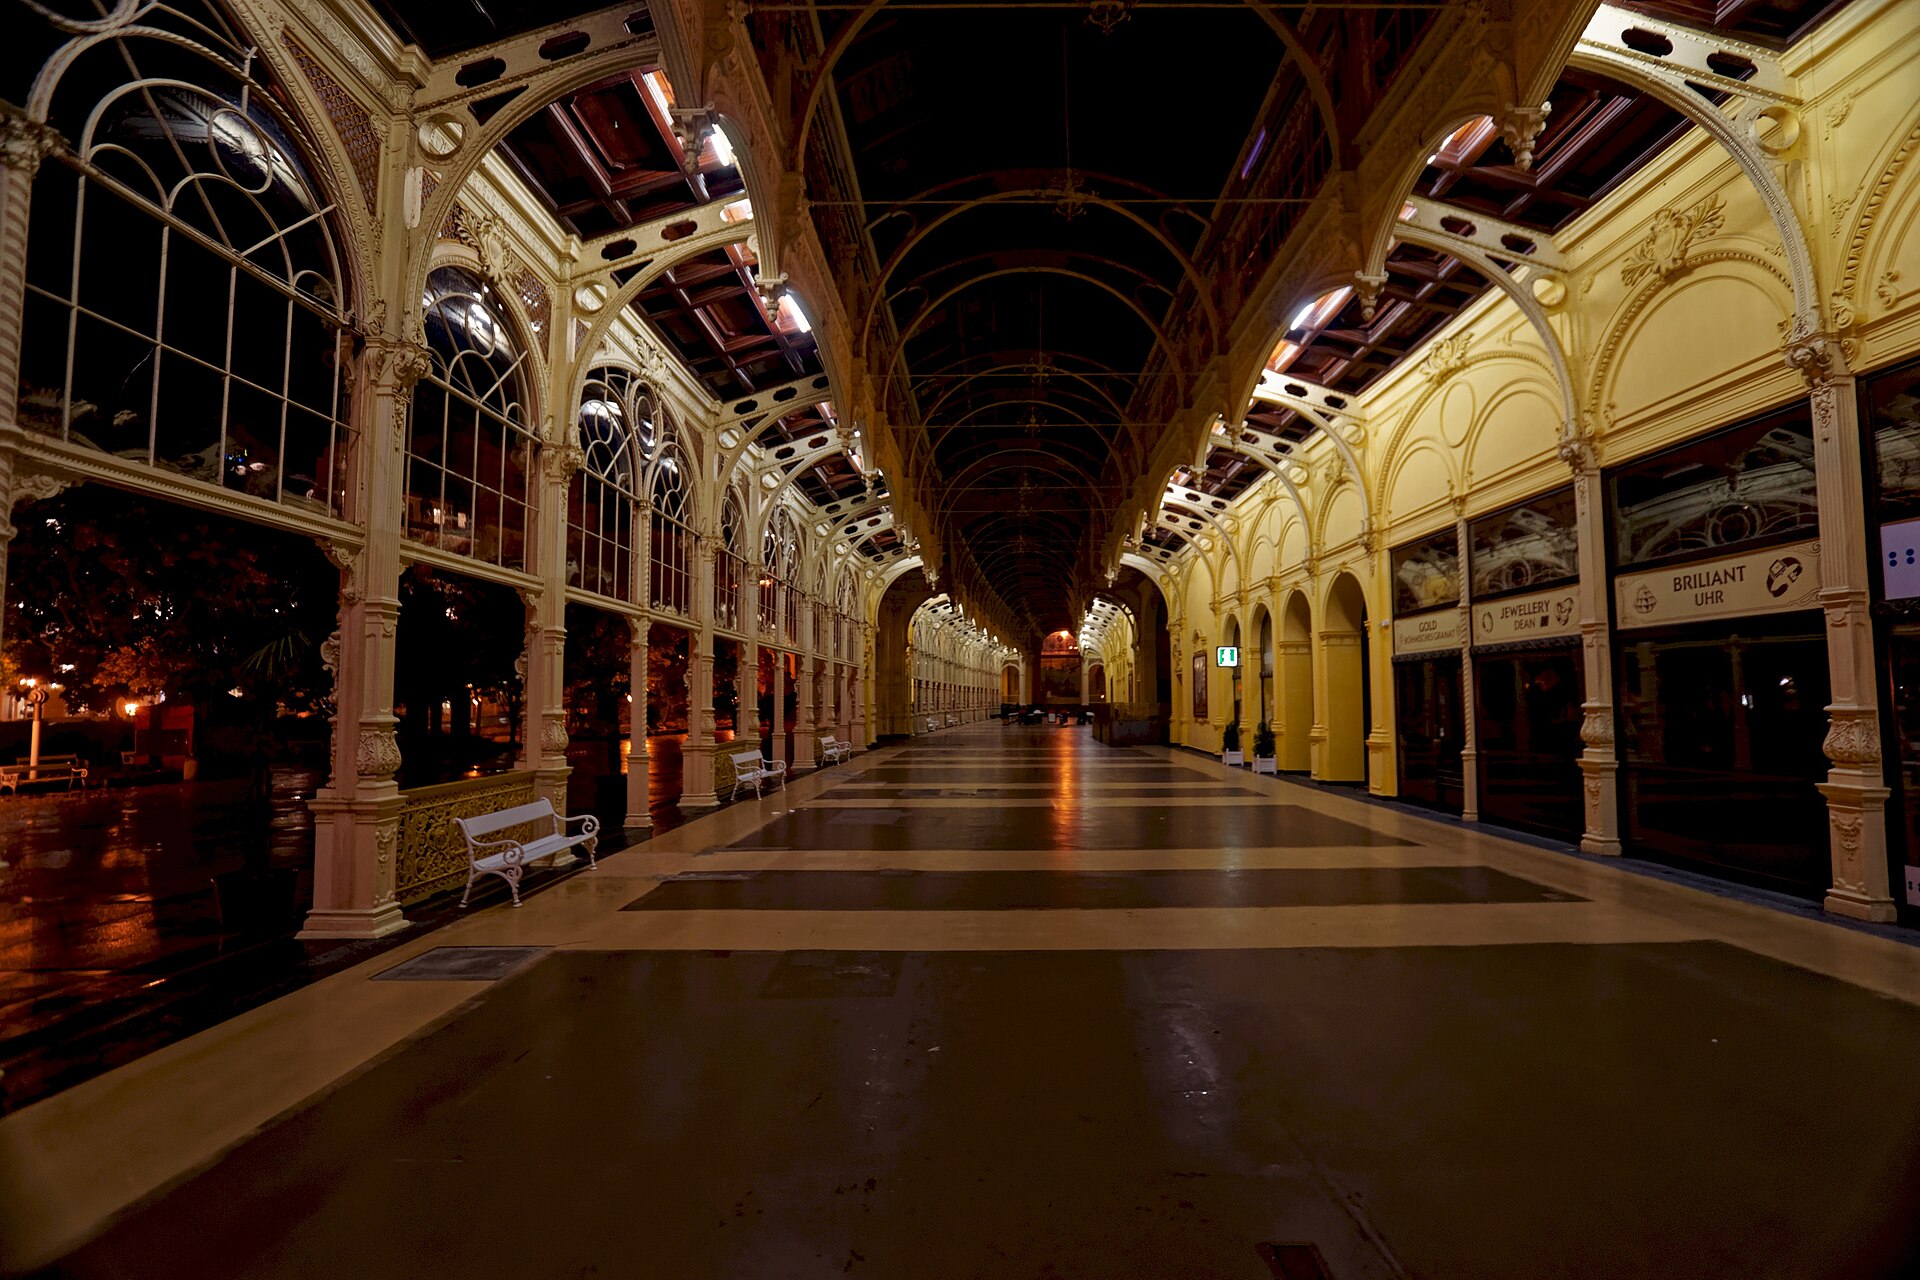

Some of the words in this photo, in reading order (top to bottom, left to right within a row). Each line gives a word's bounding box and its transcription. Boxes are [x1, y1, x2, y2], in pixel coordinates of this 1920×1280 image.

[1673, 565, 1746, 592] BRILIANT
[1695, 590, 1724, 606] UHR
[1501, 600, 1550, 619] JEWELLERY
[1419, 620, 1437, 632] GOLD
[1514, 617, 1536, 631] DEAN
